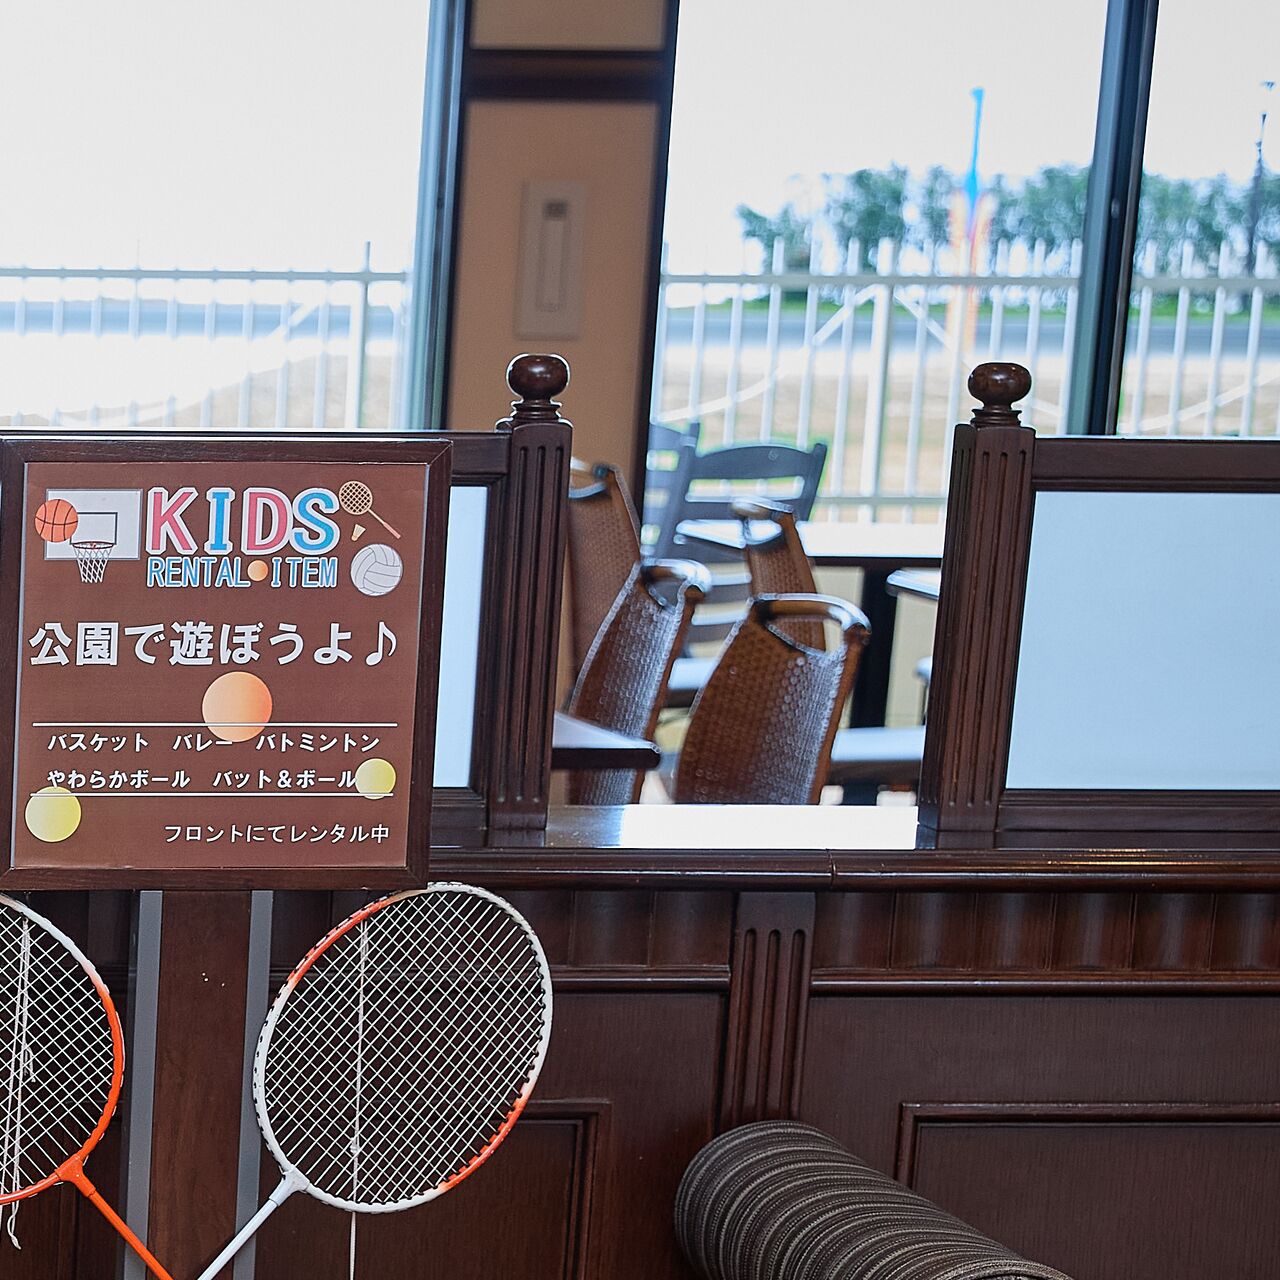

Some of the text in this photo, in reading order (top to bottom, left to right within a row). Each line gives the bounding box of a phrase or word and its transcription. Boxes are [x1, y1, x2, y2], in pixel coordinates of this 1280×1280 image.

[145, 486, 340, 556] KIDS
[146, 557, 339, 589] RENTAL ITEM
[47, 733, 381, 753] バスケット バレー バトミントン
[47, 769, 191, 790] やわらかボール
[164, 822, 391, 845] フロントにてレンタル中
